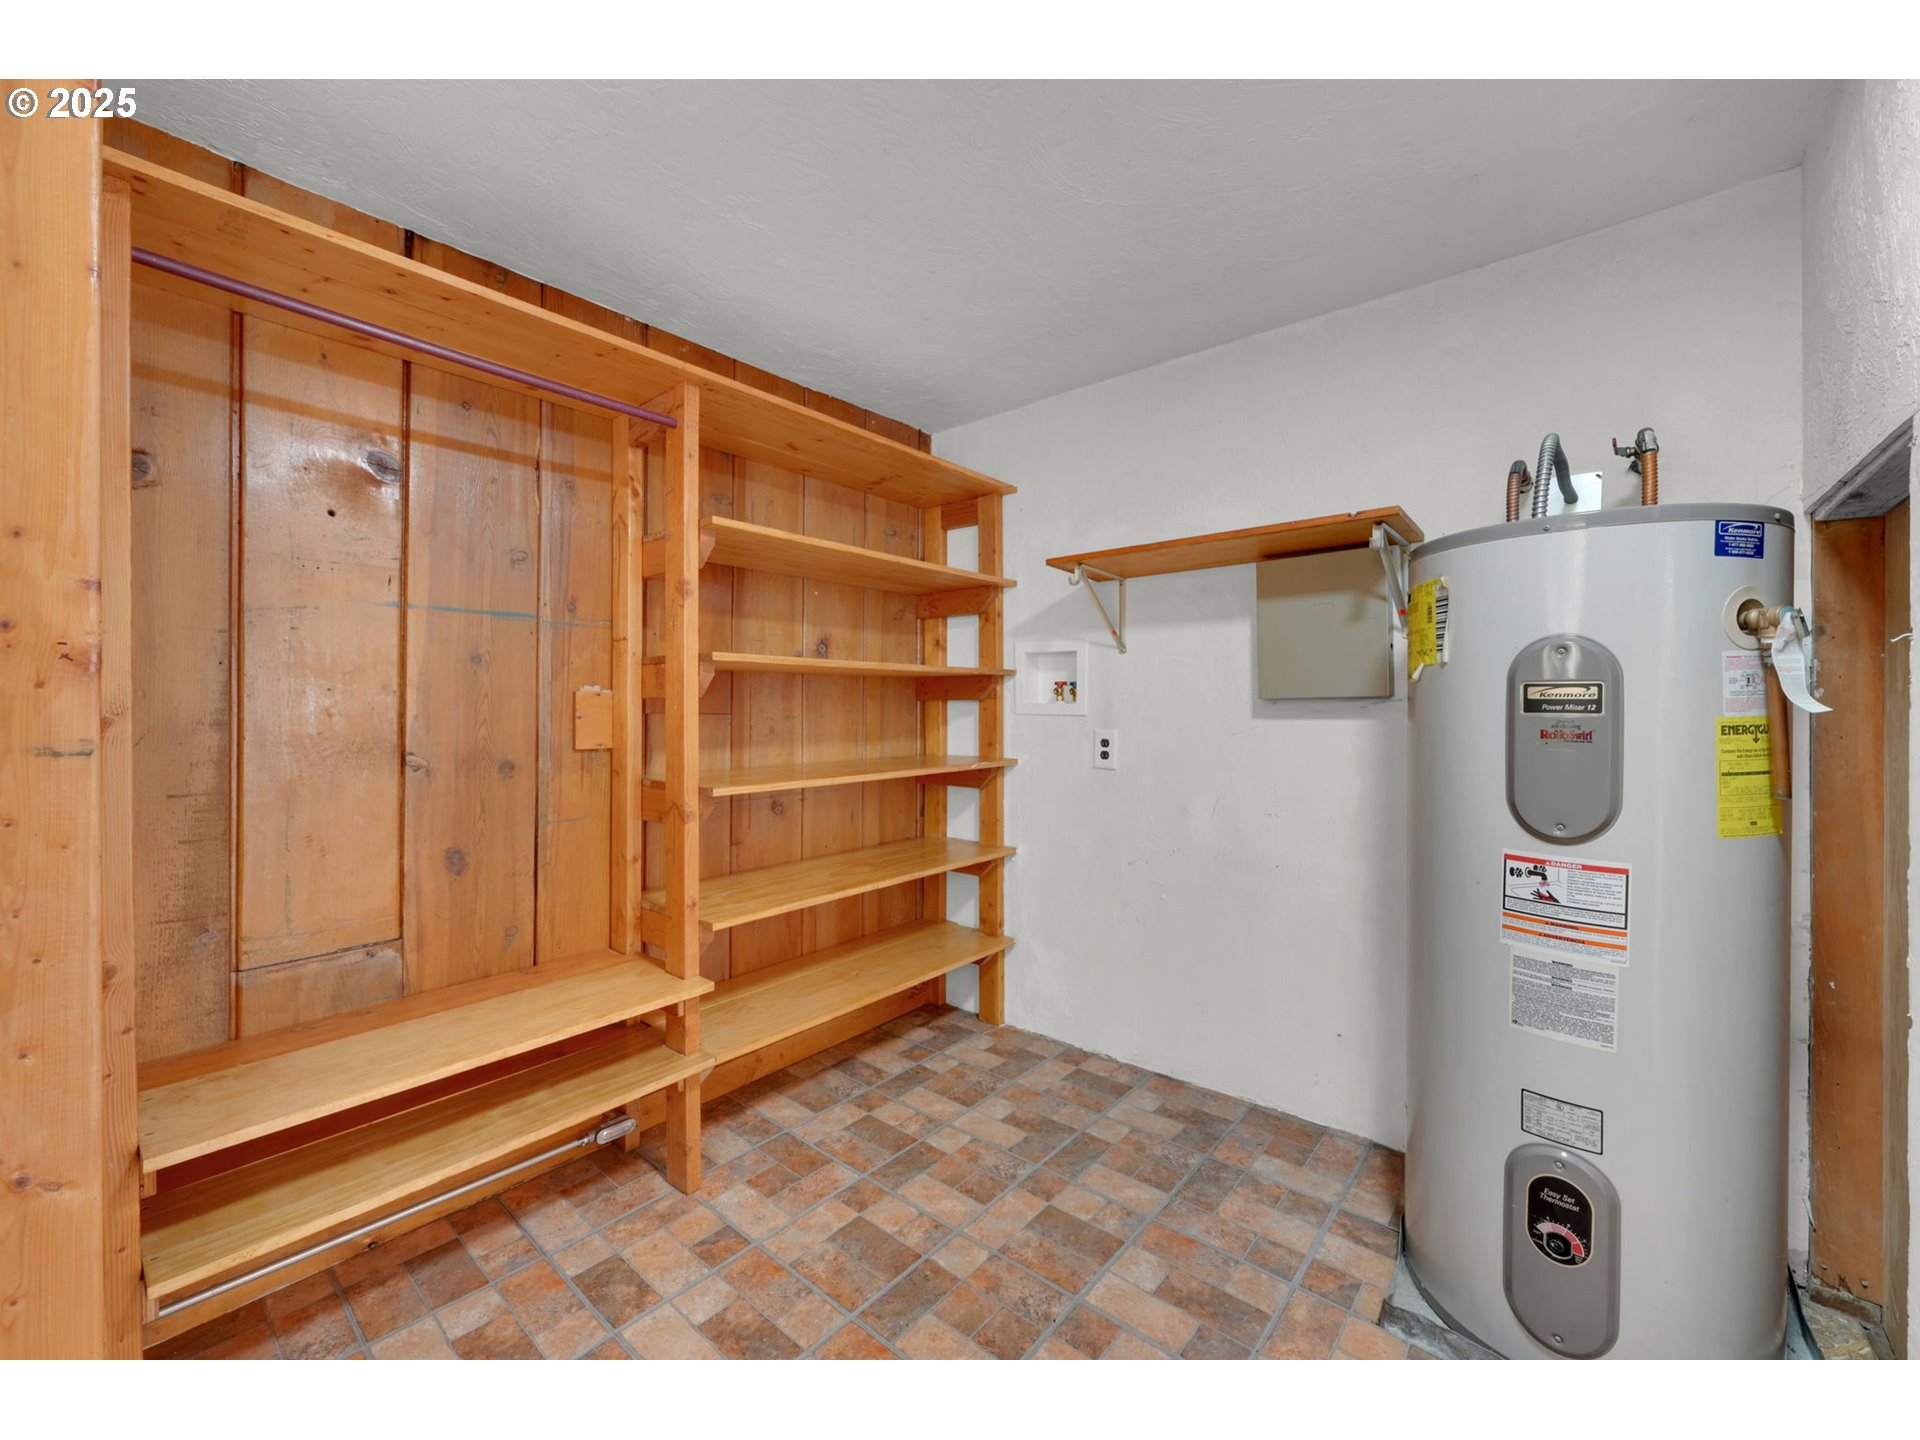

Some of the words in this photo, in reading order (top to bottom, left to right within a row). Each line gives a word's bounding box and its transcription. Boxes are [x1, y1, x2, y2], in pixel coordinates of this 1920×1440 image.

[1541, 703, 1563, 711] Power
[1564, 703, 1586, 711] Miser
[1721, 724, 1769, 737] ENERGYGU
[1550, 861, 1583, 870] DANGER
[1539, 1192, 1581, 1212] Thermostat
[1543, 1187, 1562, 1200] Easy
[1562, 1193, 1576, 1204] Set
